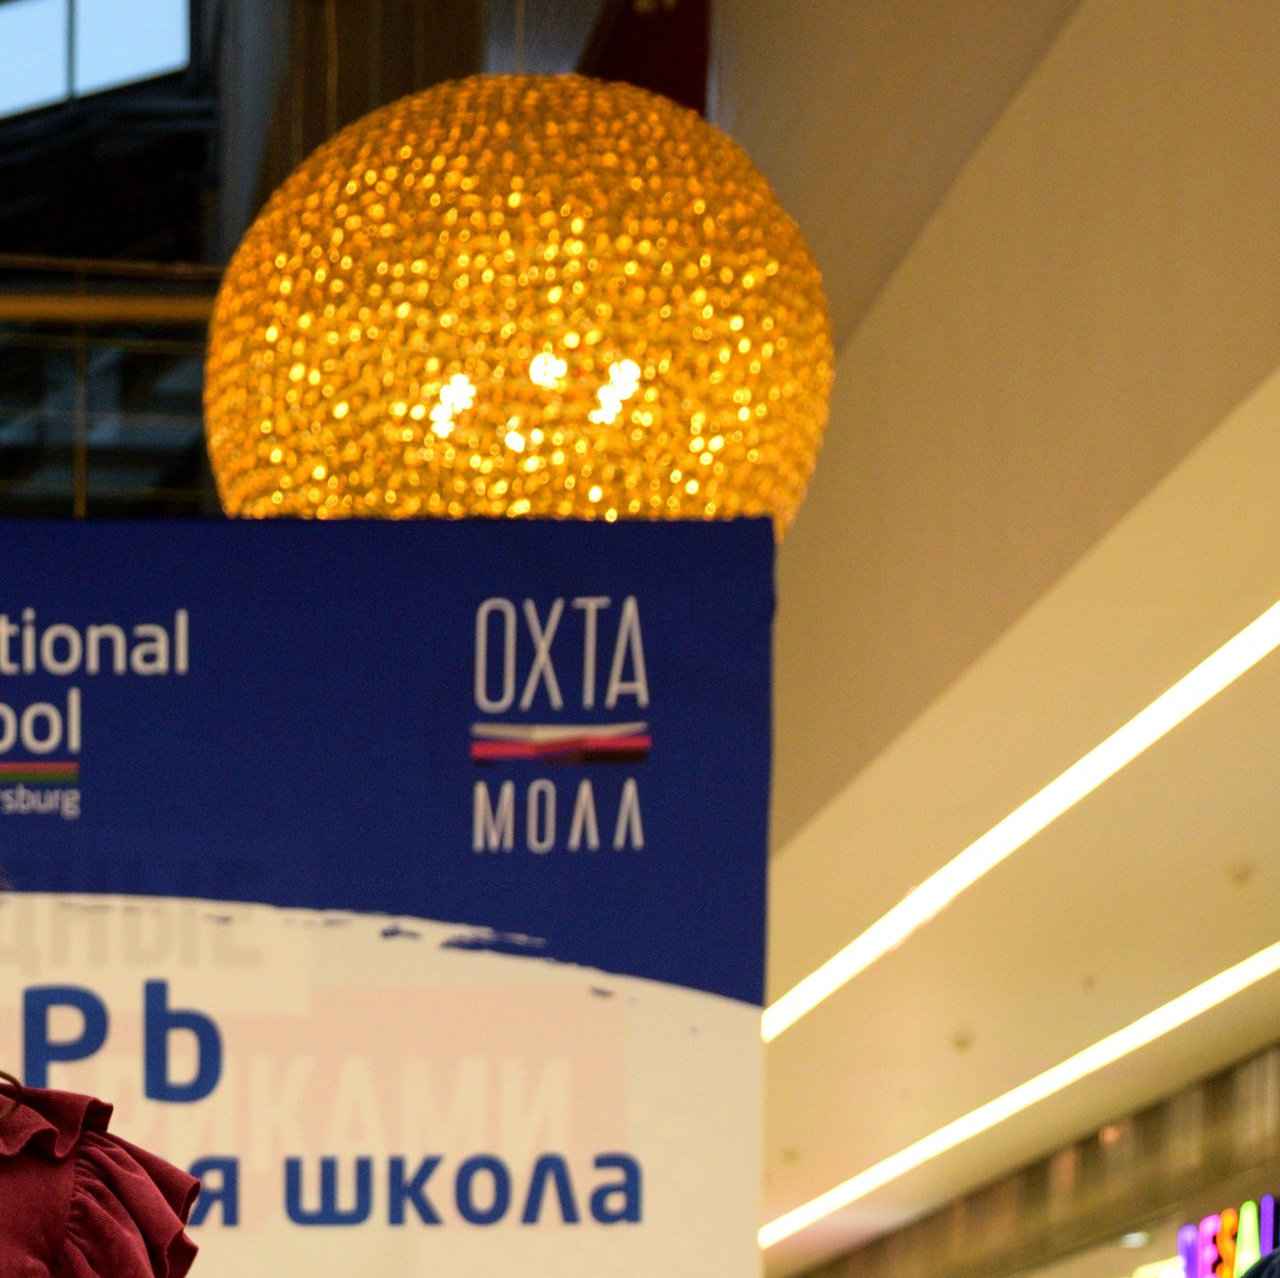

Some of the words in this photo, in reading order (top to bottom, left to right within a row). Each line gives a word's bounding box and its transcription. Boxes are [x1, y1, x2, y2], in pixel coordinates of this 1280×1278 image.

[473, 595, 650, 713] ОХТА
[471, 777, 645, 853] МОЛЛ
[282, 1152, 644, 1228] школа
